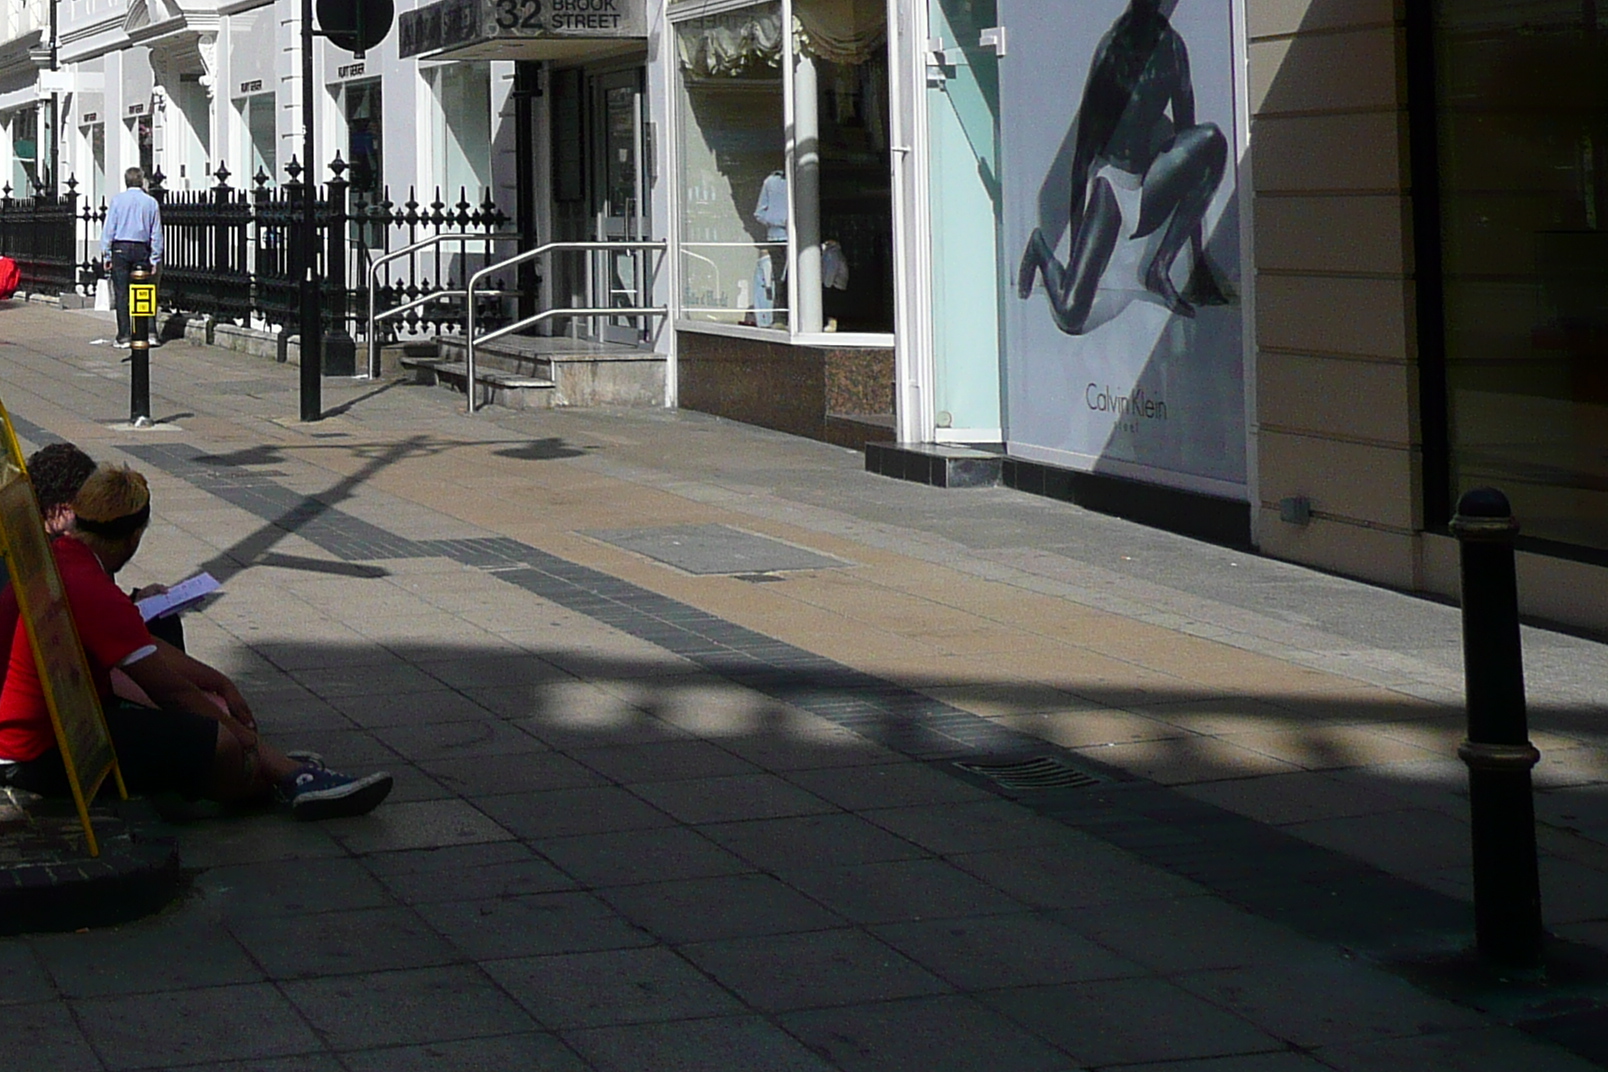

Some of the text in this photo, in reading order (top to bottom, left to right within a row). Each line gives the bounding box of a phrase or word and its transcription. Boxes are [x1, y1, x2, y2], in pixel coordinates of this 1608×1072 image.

[551, 13, 621, 28] STREET
[1085, 382, 1168, 421] Calvin Klein
